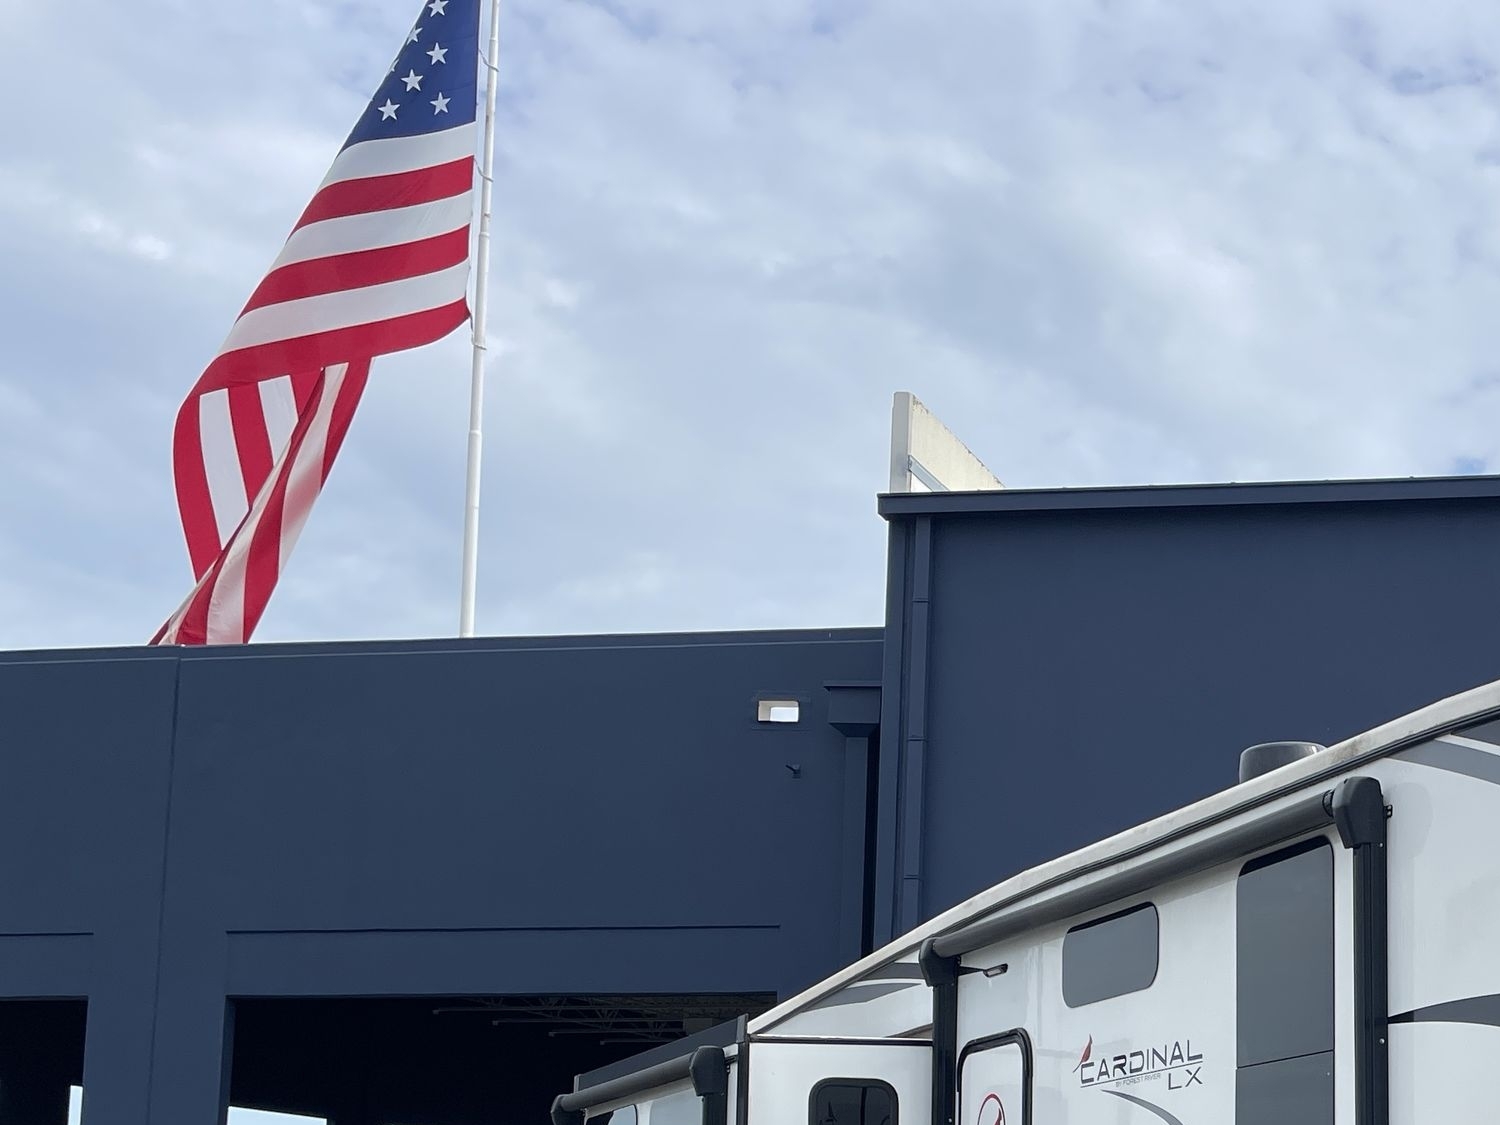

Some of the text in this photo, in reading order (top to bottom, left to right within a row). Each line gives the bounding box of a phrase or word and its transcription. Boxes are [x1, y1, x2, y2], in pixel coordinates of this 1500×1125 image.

[1079, 1040, 1203, 1084] CARDINAL
[1122, 1076, 1144, 1085] FOREST
[1144, 1073, 1161, 1081] RIVER
[1168, 1066, 1203, 1090] LX
